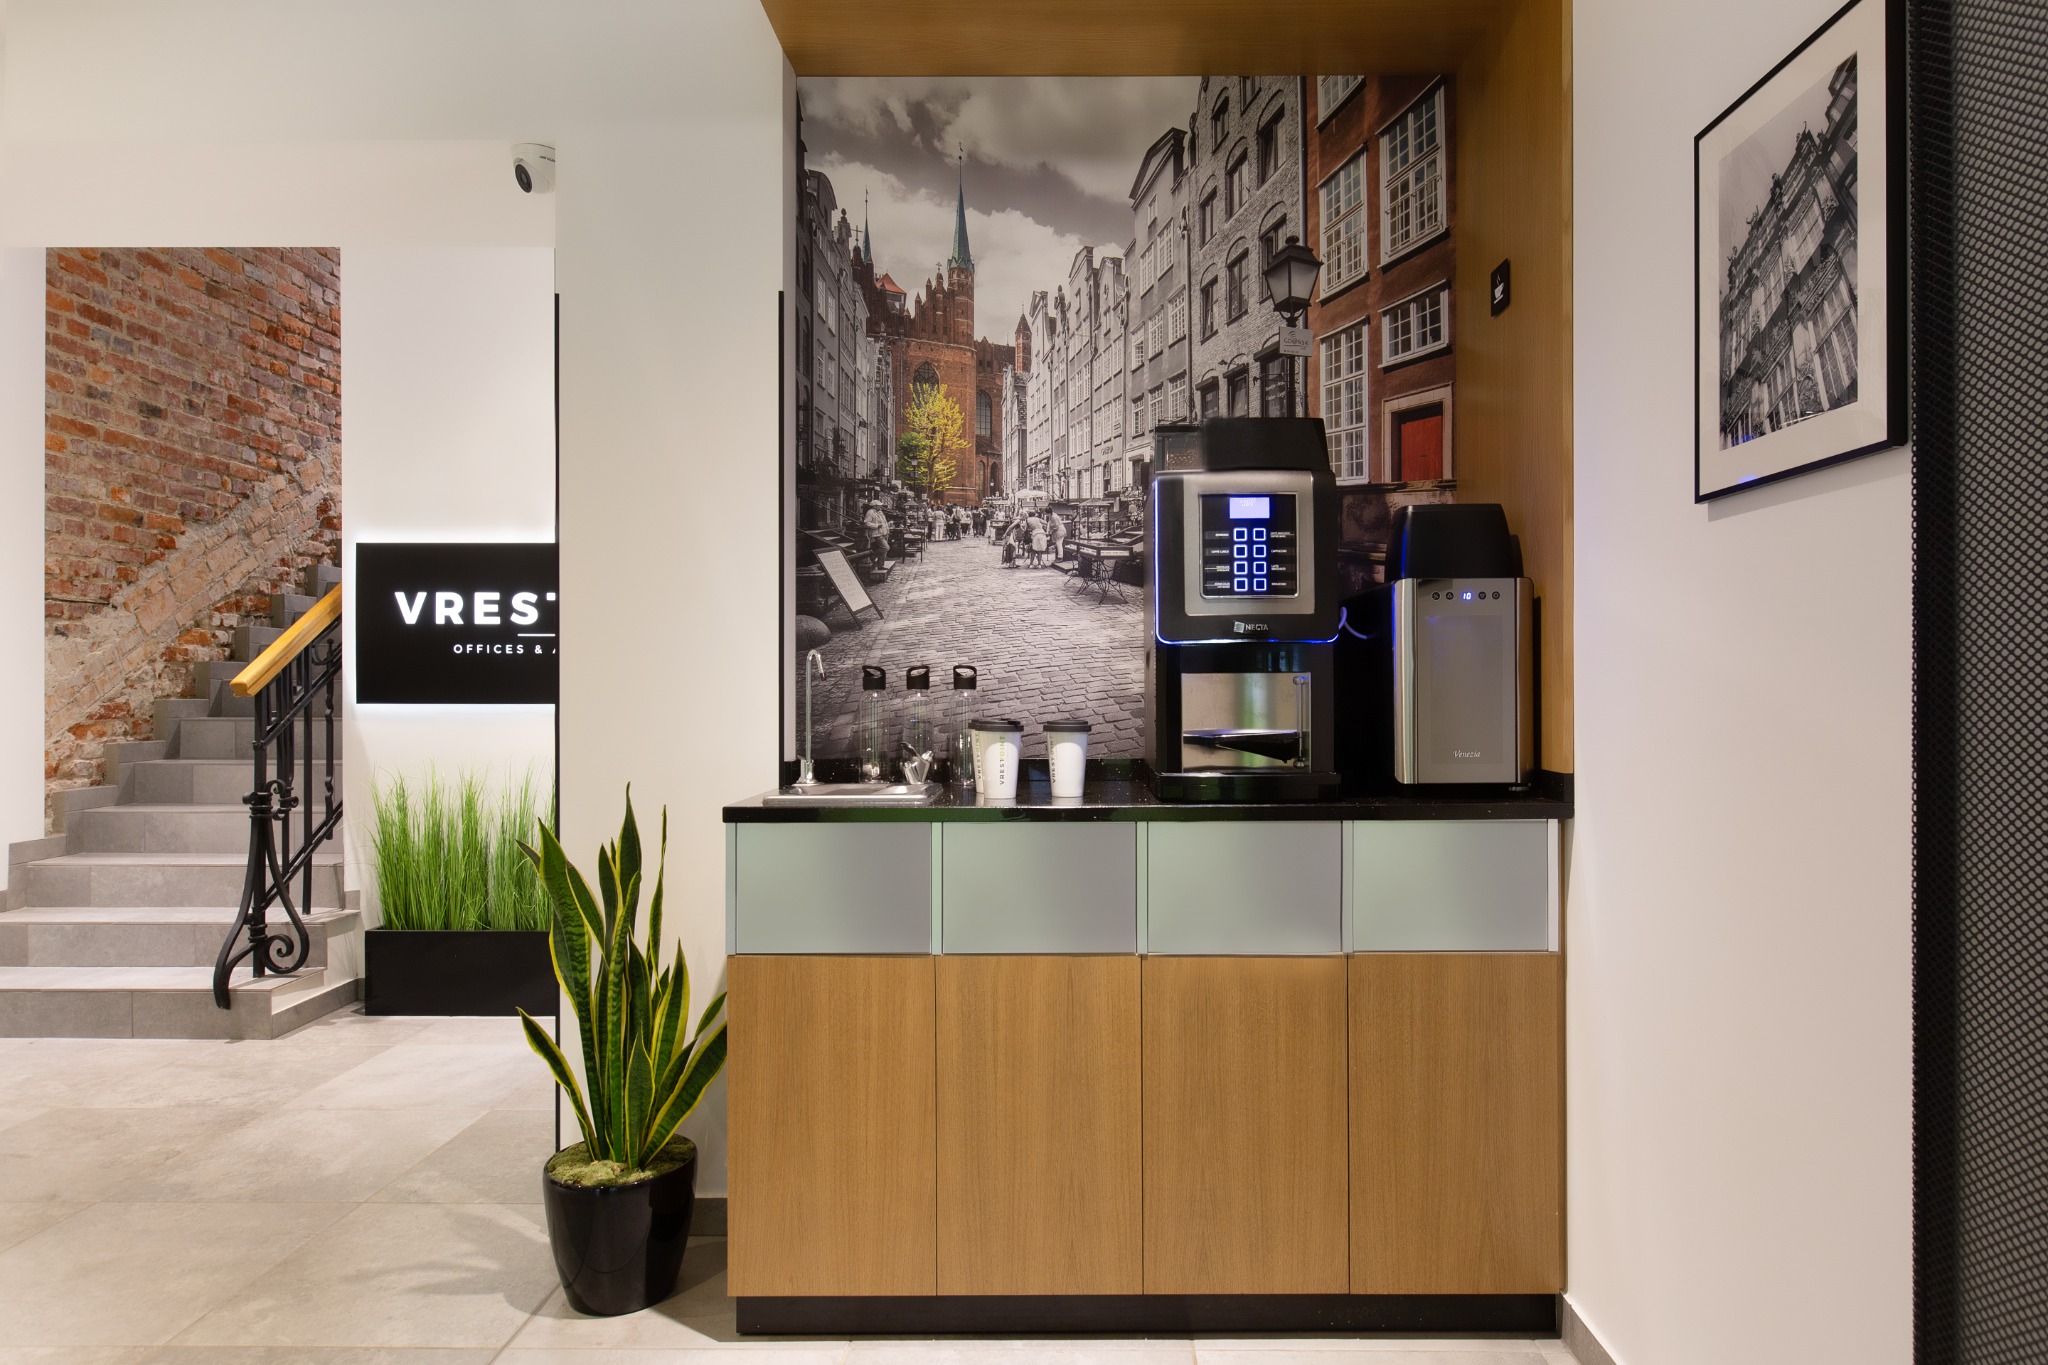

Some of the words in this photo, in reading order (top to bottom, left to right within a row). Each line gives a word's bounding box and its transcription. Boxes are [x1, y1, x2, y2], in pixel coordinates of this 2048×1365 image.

[1463, 592, 1472, 600] 10
[1245, 623, 1269, 631] NECTA
[453, 644, 524, 654] OFFICES
[534, 644, 542, 654] &
[1452, 749, 1481, 758] Venezia
